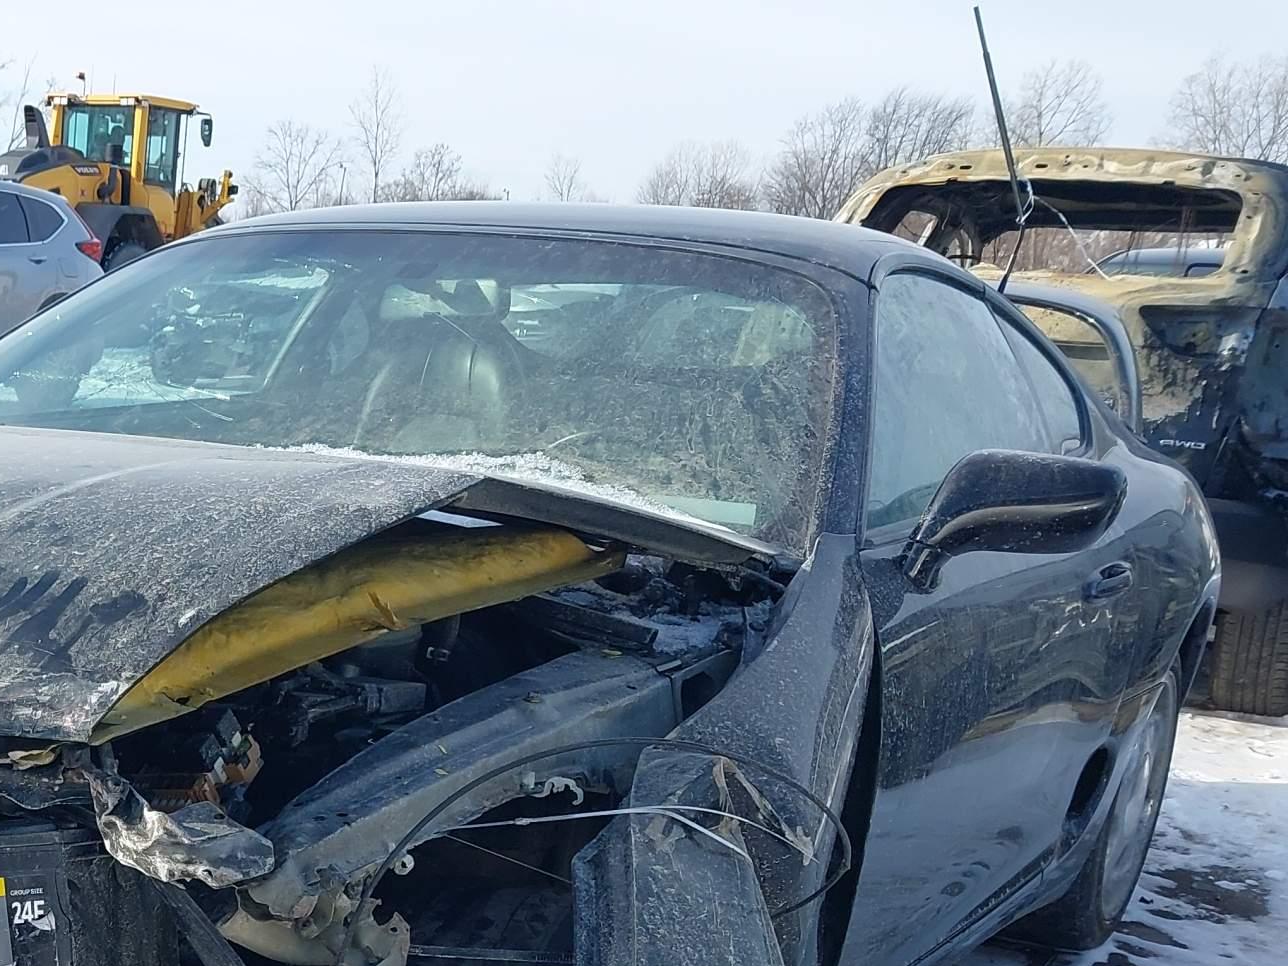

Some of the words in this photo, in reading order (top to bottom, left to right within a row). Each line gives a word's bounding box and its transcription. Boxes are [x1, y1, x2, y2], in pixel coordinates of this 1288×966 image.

[1159, 439, 1206, 450] AWD
[30, 887, 44, 895] SIZE
[11, 900, 45, 924] 24F
